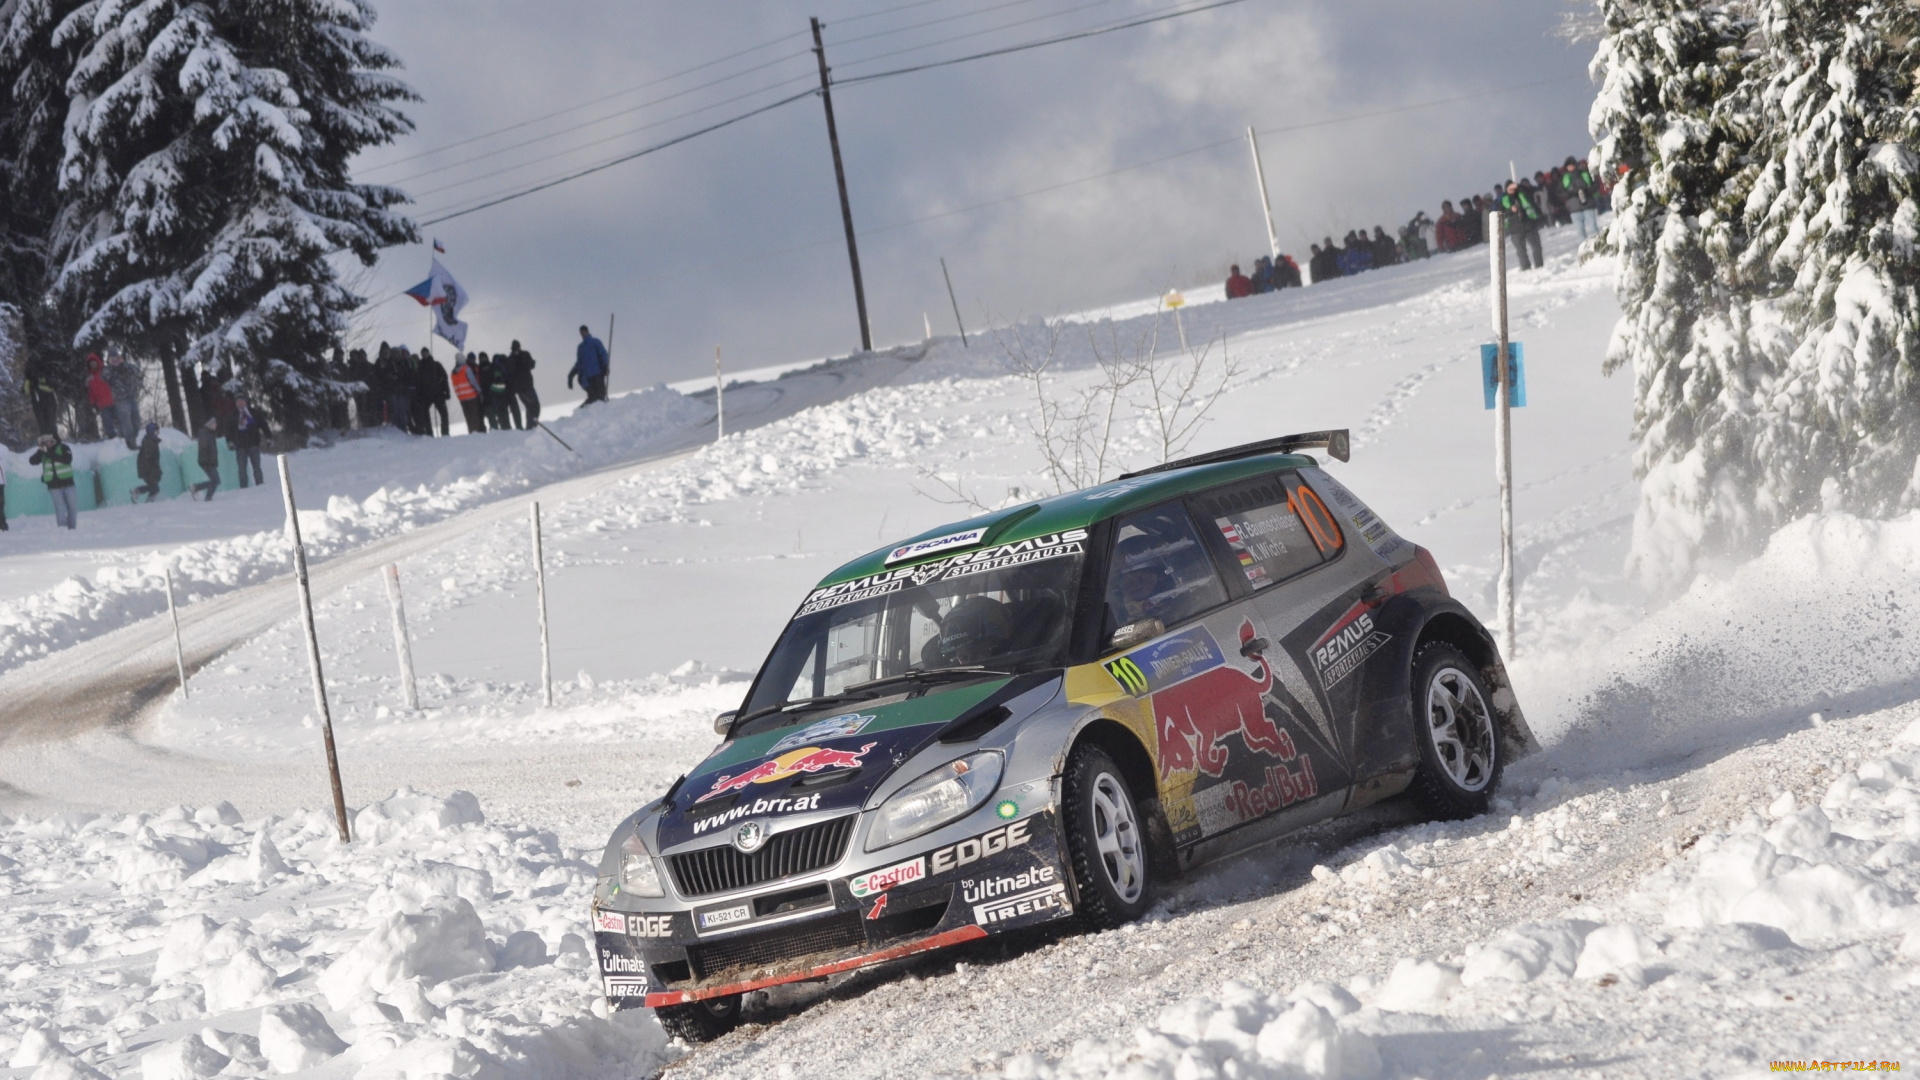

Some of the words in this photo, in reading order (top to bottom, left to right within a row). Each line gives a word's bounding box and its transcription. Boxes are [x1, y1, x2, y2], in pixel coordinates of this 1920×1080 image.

[1243, 513, 1299, 537] Baumschlager
[1287, 485, 1343, 552] 10
[914, 532, 978, 551] SCANIA
[946, 529, 1088, 568] REMUS
[1256, 540, 1288, 559] Wicha
[951, 544, 1075, 577] SPORTEXHAUST
[801, 584, 896, 615] SPORTEXHAUST
[804, 566, 915, 604] REMUS
[1316, 612, 1374, 670] REMUS
[1326, 634, 1382, 684] SPORTEXHAUST
[1110, 657, 1149, 697] 10
[693, 792, 821, 834] www.brr.at
[931, 818, 1033, 875] EDGE
[868, 861, 922, 891] Castrol
[961, 878, 975, 889] bp
[963, 865, 1055, 903] ultimate
[707, 911, 732, 924] KI-521
[733, 908, 747, 919] CR
[973, 882, 1073, 926] PIRELLI
[602, 914, 625, 931] Castrol
[628, 914, 673, 938] EDGE
[602, 948, 610, 958] bp
[603, 953, 646, 973] ultimate
[603, 975, 649, 997] PIRELLI
